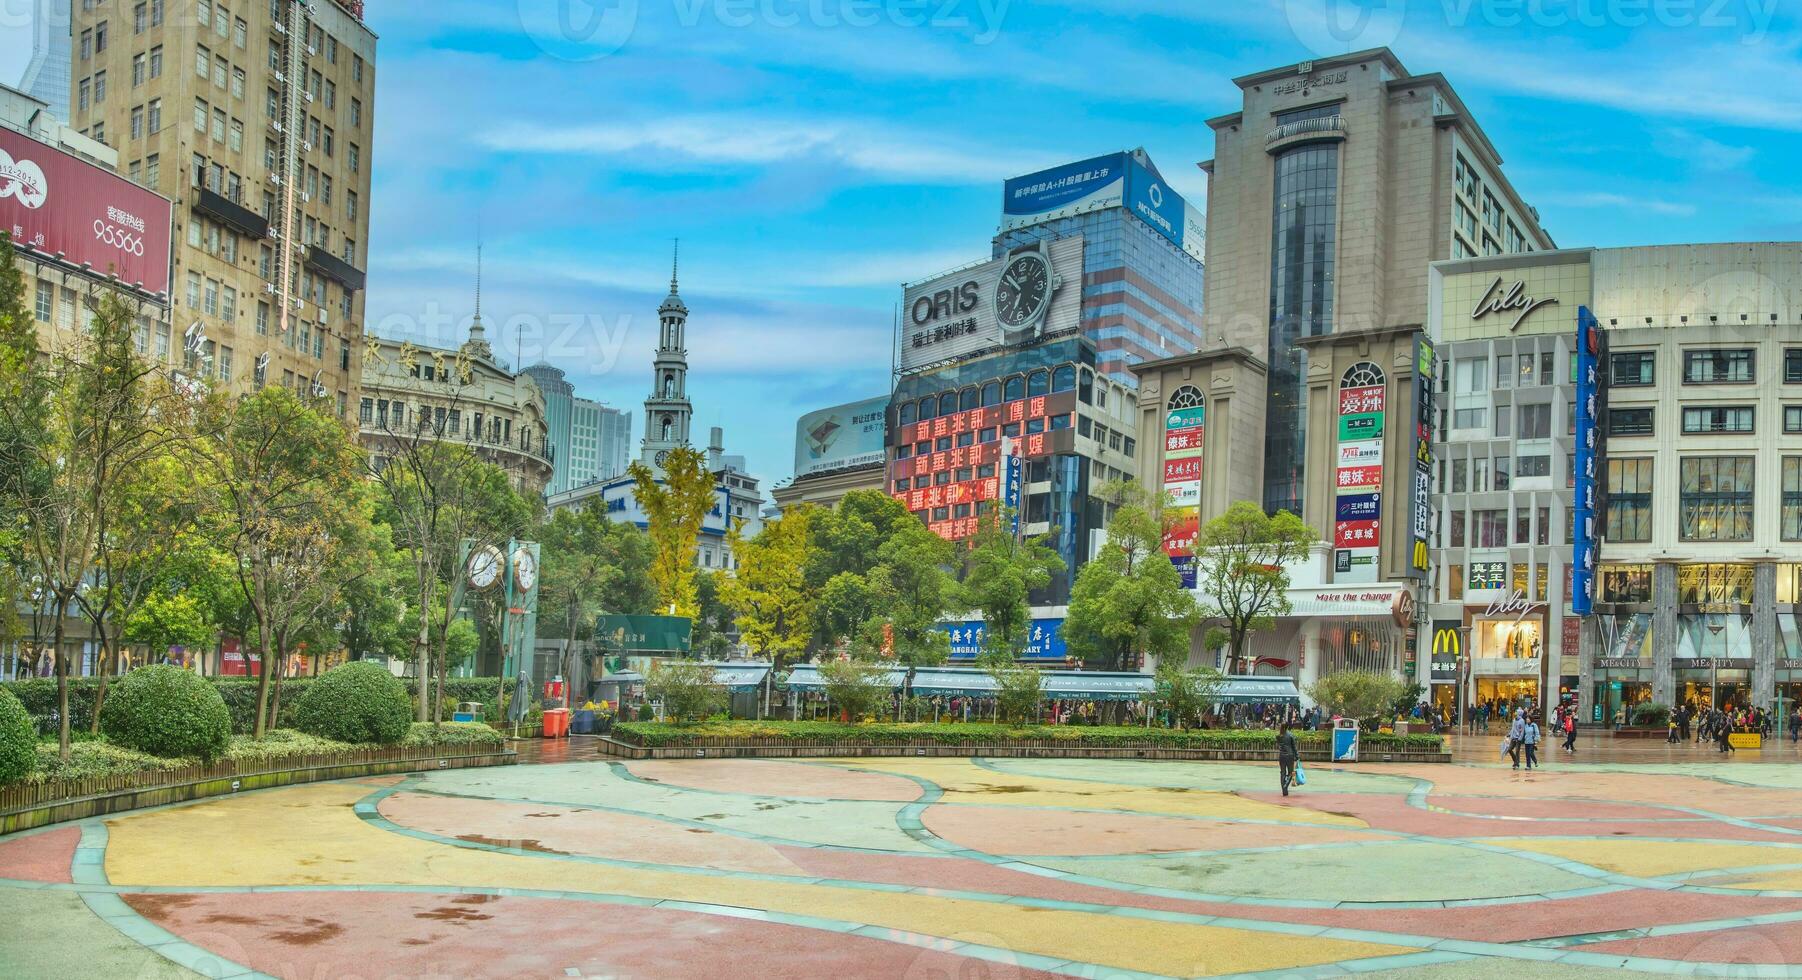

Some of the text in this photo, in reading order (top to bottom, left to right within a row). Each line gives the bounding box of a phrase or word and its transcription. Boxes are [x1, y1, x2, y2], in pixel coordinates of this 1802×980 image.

[0, 165, 38, 187] 12-2012
[94, 219, 144, 257] 95566
[911, 280, 979, 326] ORIS
[1342, 395, 1382, 414] 爱辣
[1471, 562, 1505, 573] 真丝
[1470, 573, 1505, 583] 大王
[1315, 591, 1392, 603] Make the change
